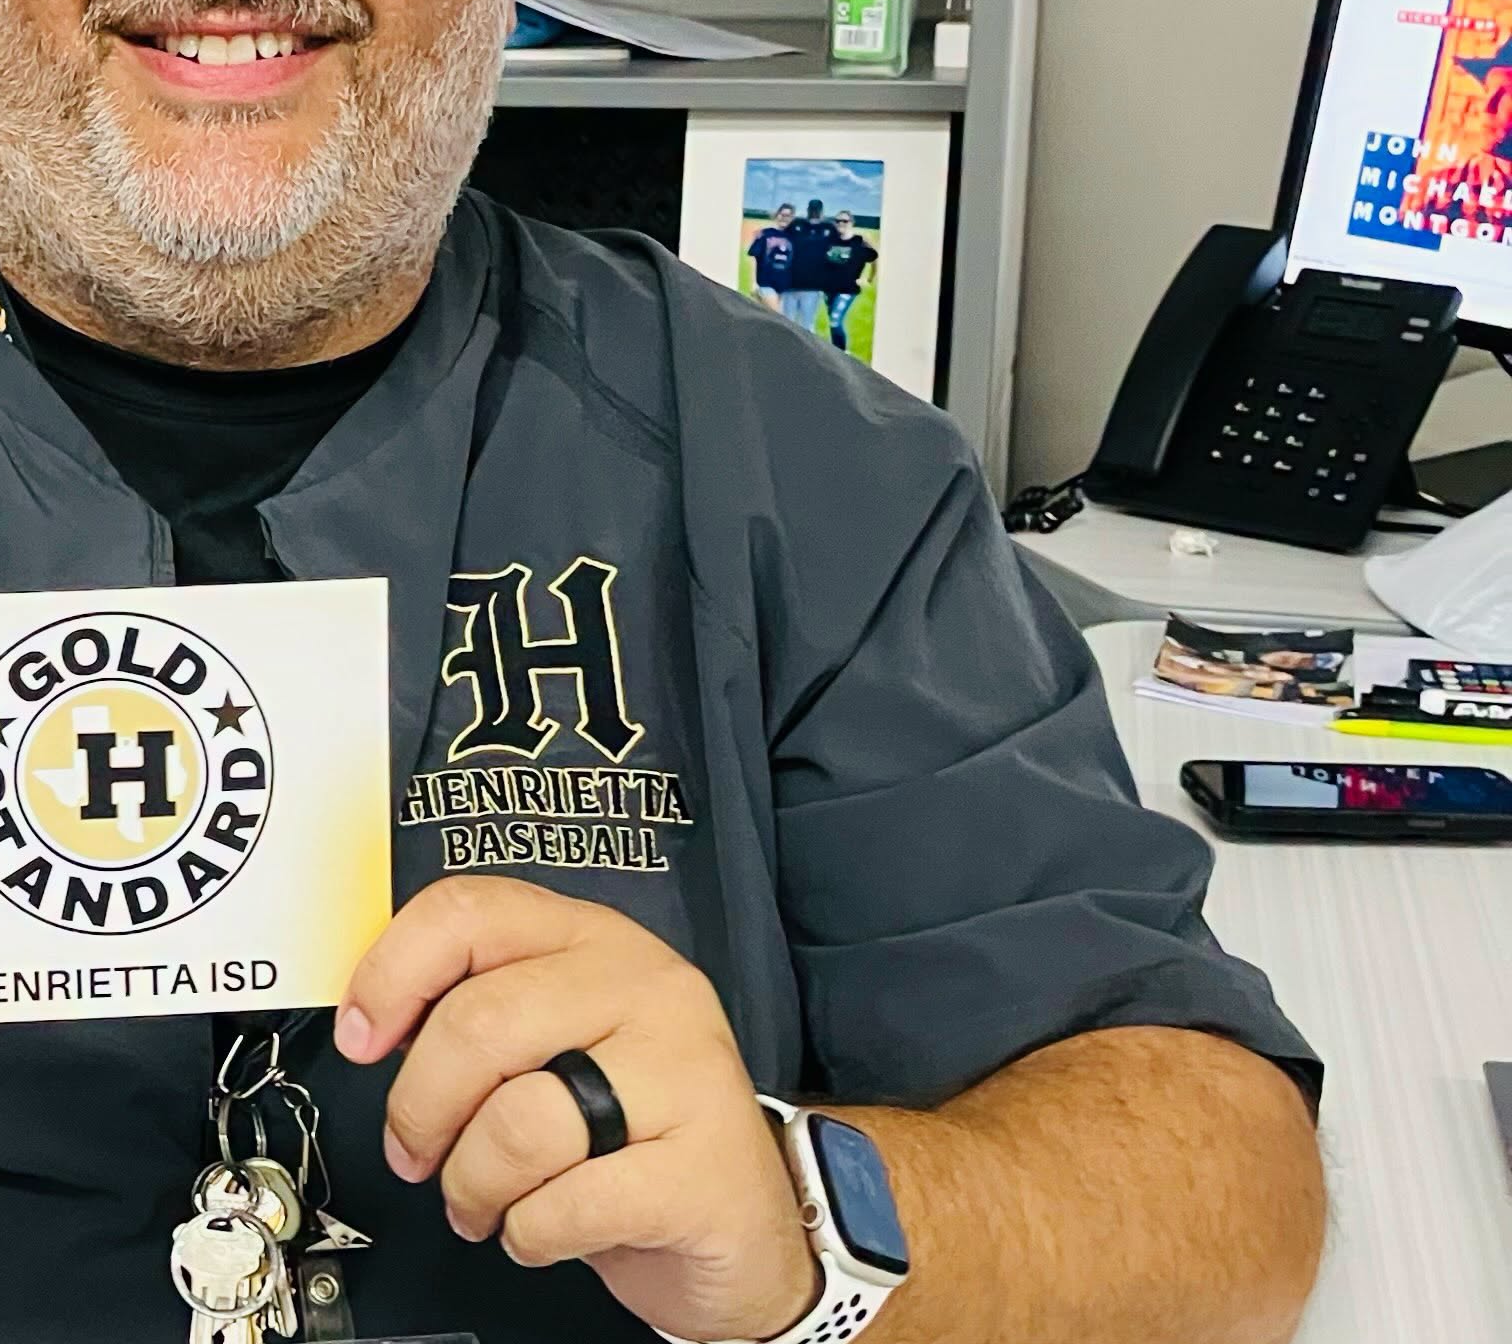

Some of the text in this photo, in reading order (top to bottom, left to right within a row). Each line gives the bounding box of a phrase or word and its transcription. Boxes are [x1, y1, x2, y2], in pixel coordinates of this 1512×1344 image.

[1366, 132, 1460, 163] JOHN
[8, 627, 208, 702] GOLD
[441, 555, 646, 764] H
[77, 730, 177, 820] H
[398, 767, 694, 825] HENRIETTA
[441, 821, 670, 871] BASEBALL
[211, 960, 278, 993] ISD
